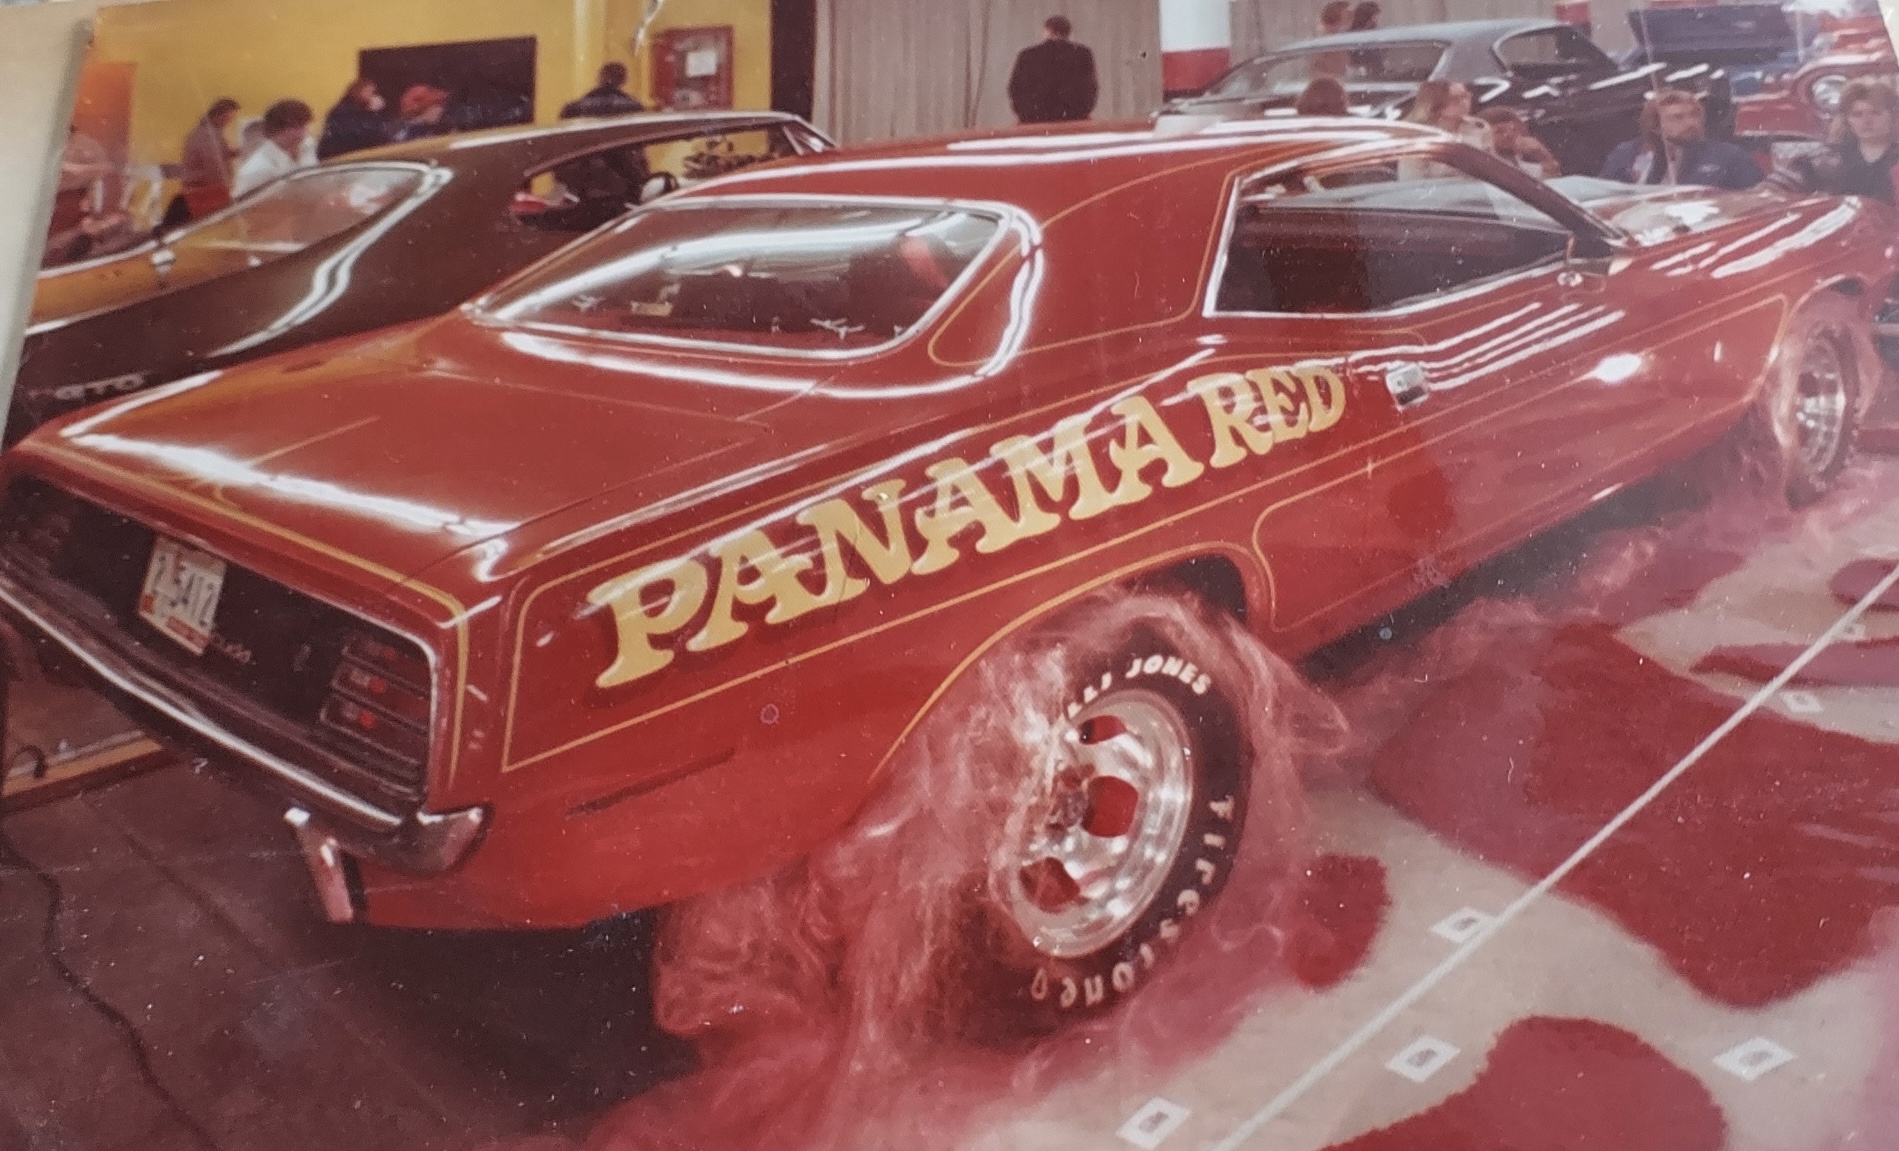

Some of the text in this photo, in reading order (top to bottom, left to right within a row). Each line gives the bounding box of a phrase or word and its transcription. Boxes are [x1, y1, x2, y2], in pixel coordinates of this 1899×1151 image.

[587, 366, 1347, 689] PANAMA RED
[1125, 654, 1212, 695] JONES
[1059, 794, 1236, 1009] Firestone
